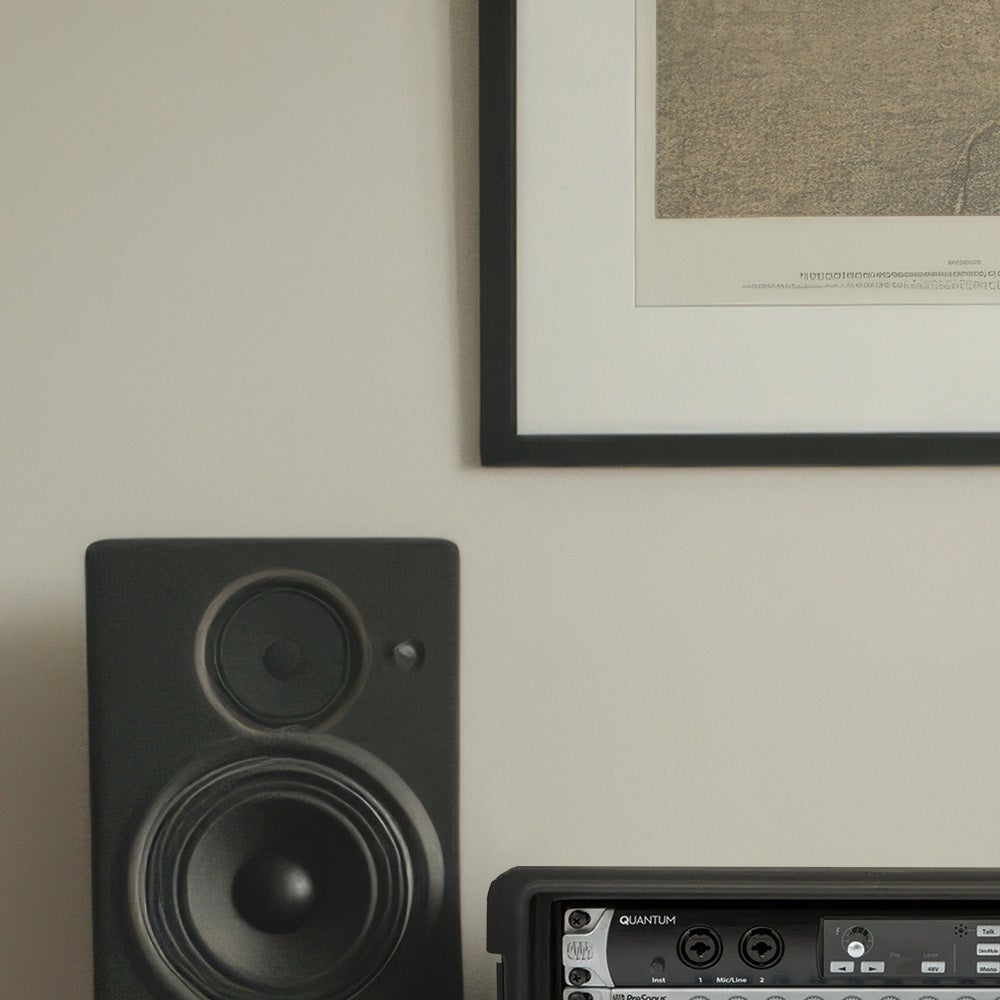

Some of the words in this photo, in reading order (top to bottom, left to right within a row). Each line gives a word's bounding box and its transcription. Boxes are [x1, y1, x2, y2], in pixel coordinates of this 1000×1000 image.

[619, 915, 676, 926] QUANTUM
[979, 965, 998, 973] Mono
[651, 976, 666, 984] Inst
[716, 976, 748, 984] Mic/Line
